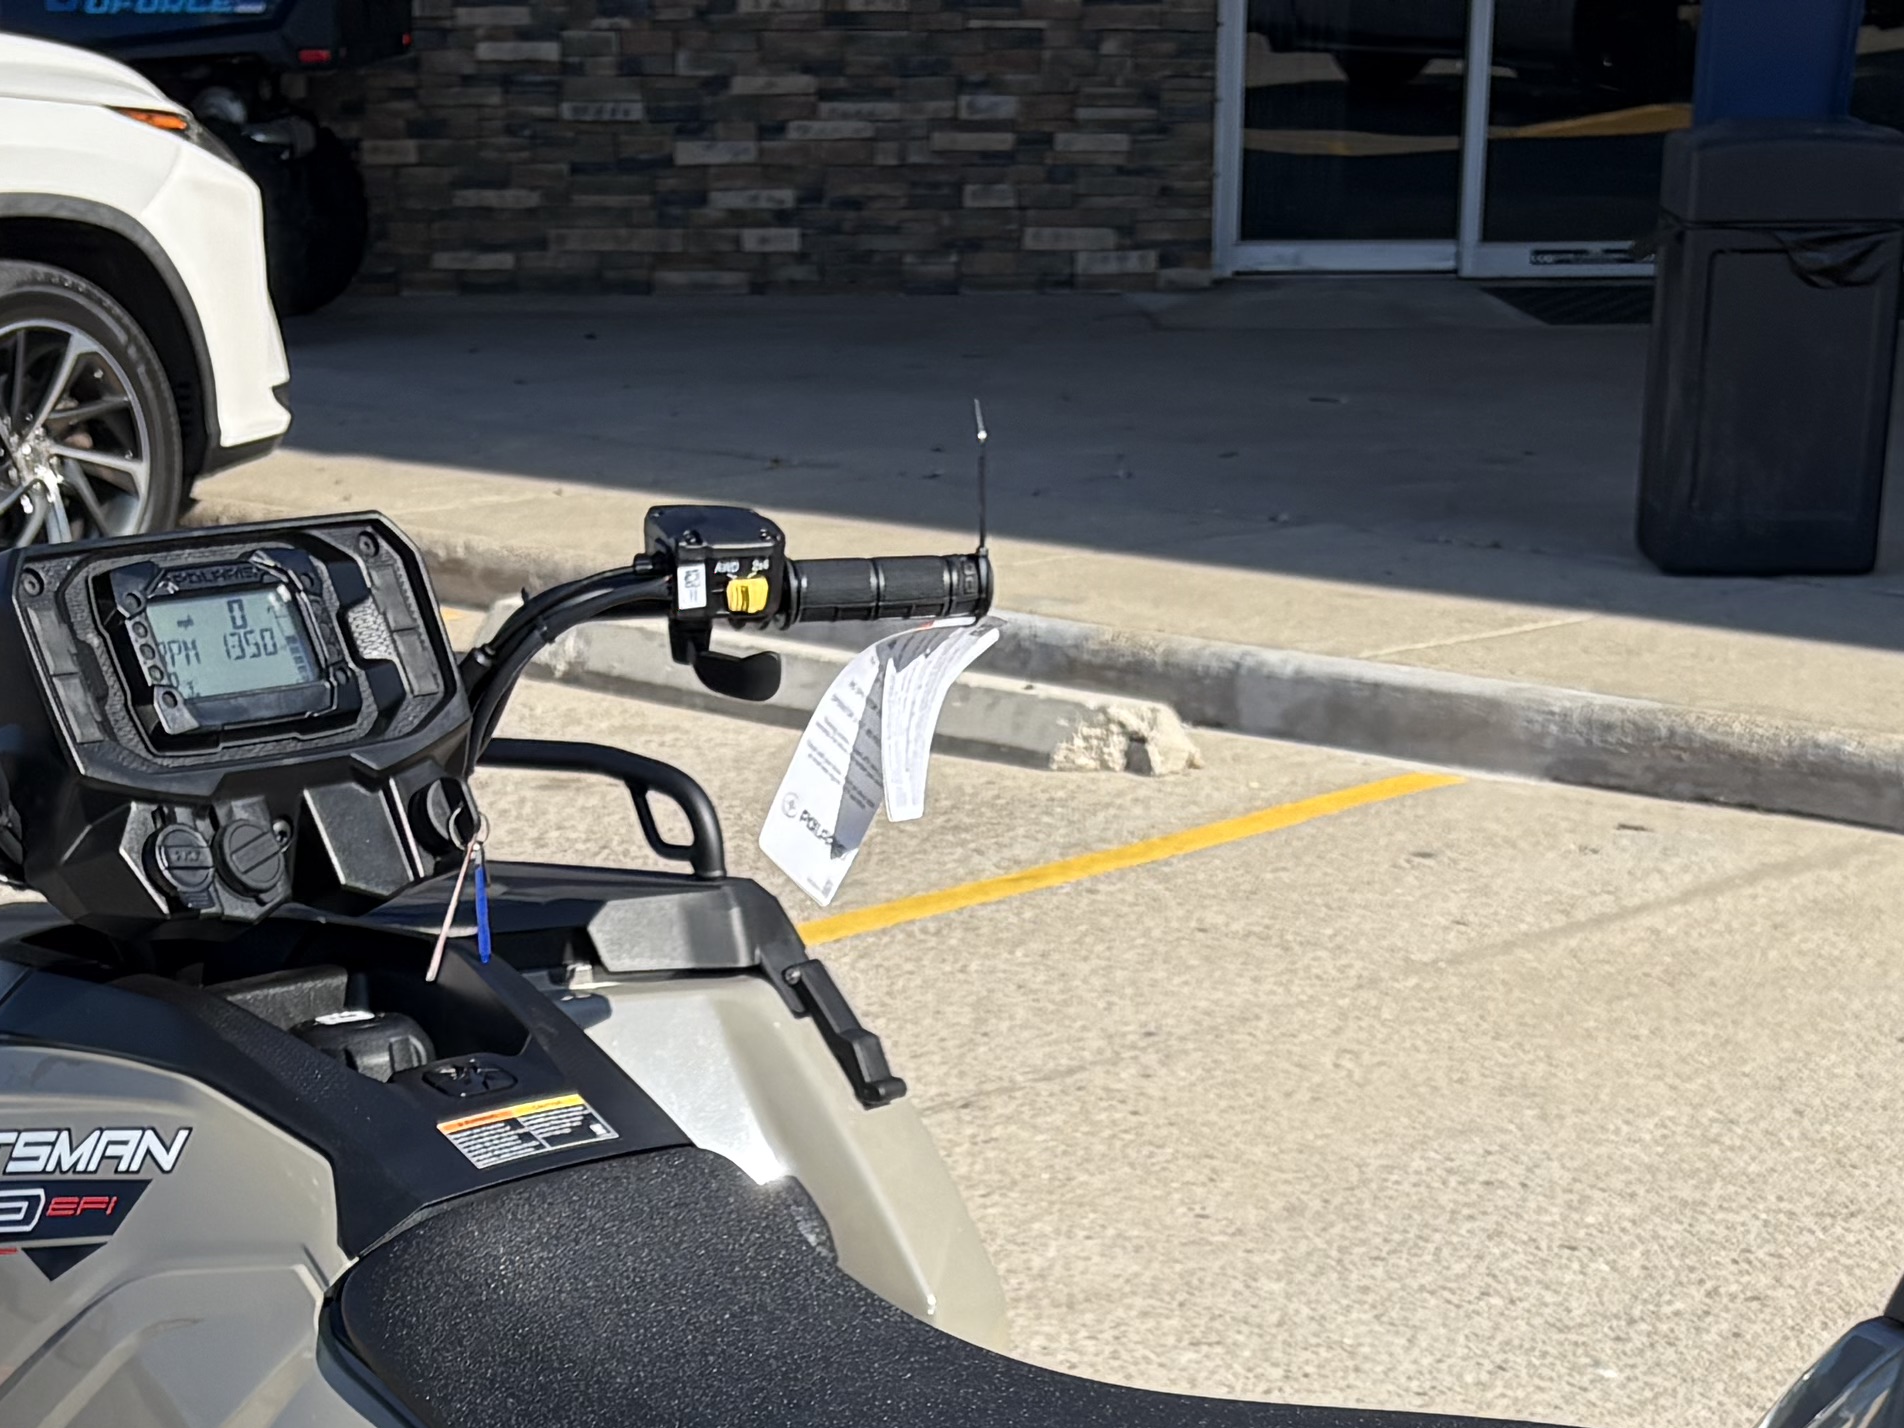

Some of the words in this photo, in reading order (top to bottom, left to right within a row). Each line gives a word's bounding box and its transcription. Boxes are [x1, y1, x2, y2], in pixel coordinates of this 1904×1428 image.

[227, 598, 248, 630] 0
[223, 627, 278, 662] 1350
[45, 1195, 117, 1218] EFI
